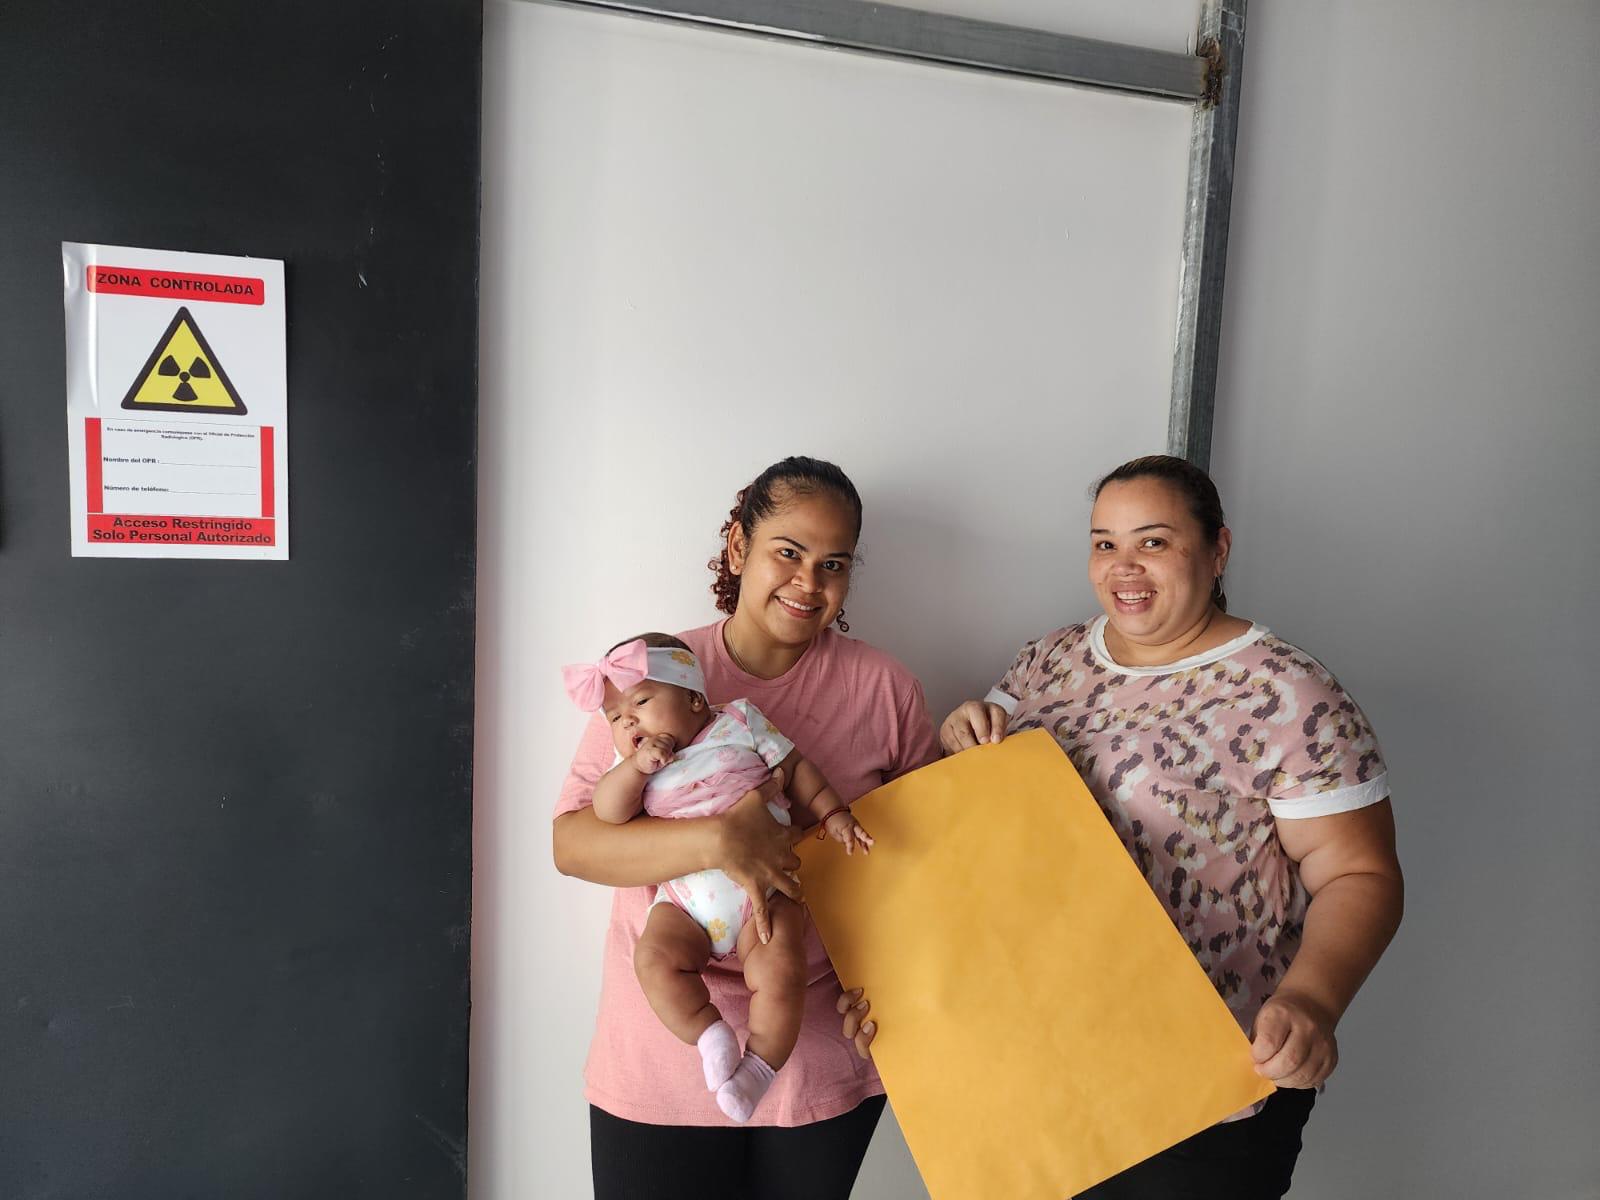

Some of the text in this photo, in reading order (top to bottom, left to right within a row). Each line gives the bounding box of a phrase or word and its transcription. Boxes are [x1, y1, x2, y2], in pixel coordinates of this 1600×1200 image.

[97, 273, 254, 296] ZONA CONTROLADA
[114, 517, 168, 529] Acceso
[93, 529, 271, 544] Solo Personal Autorizado
